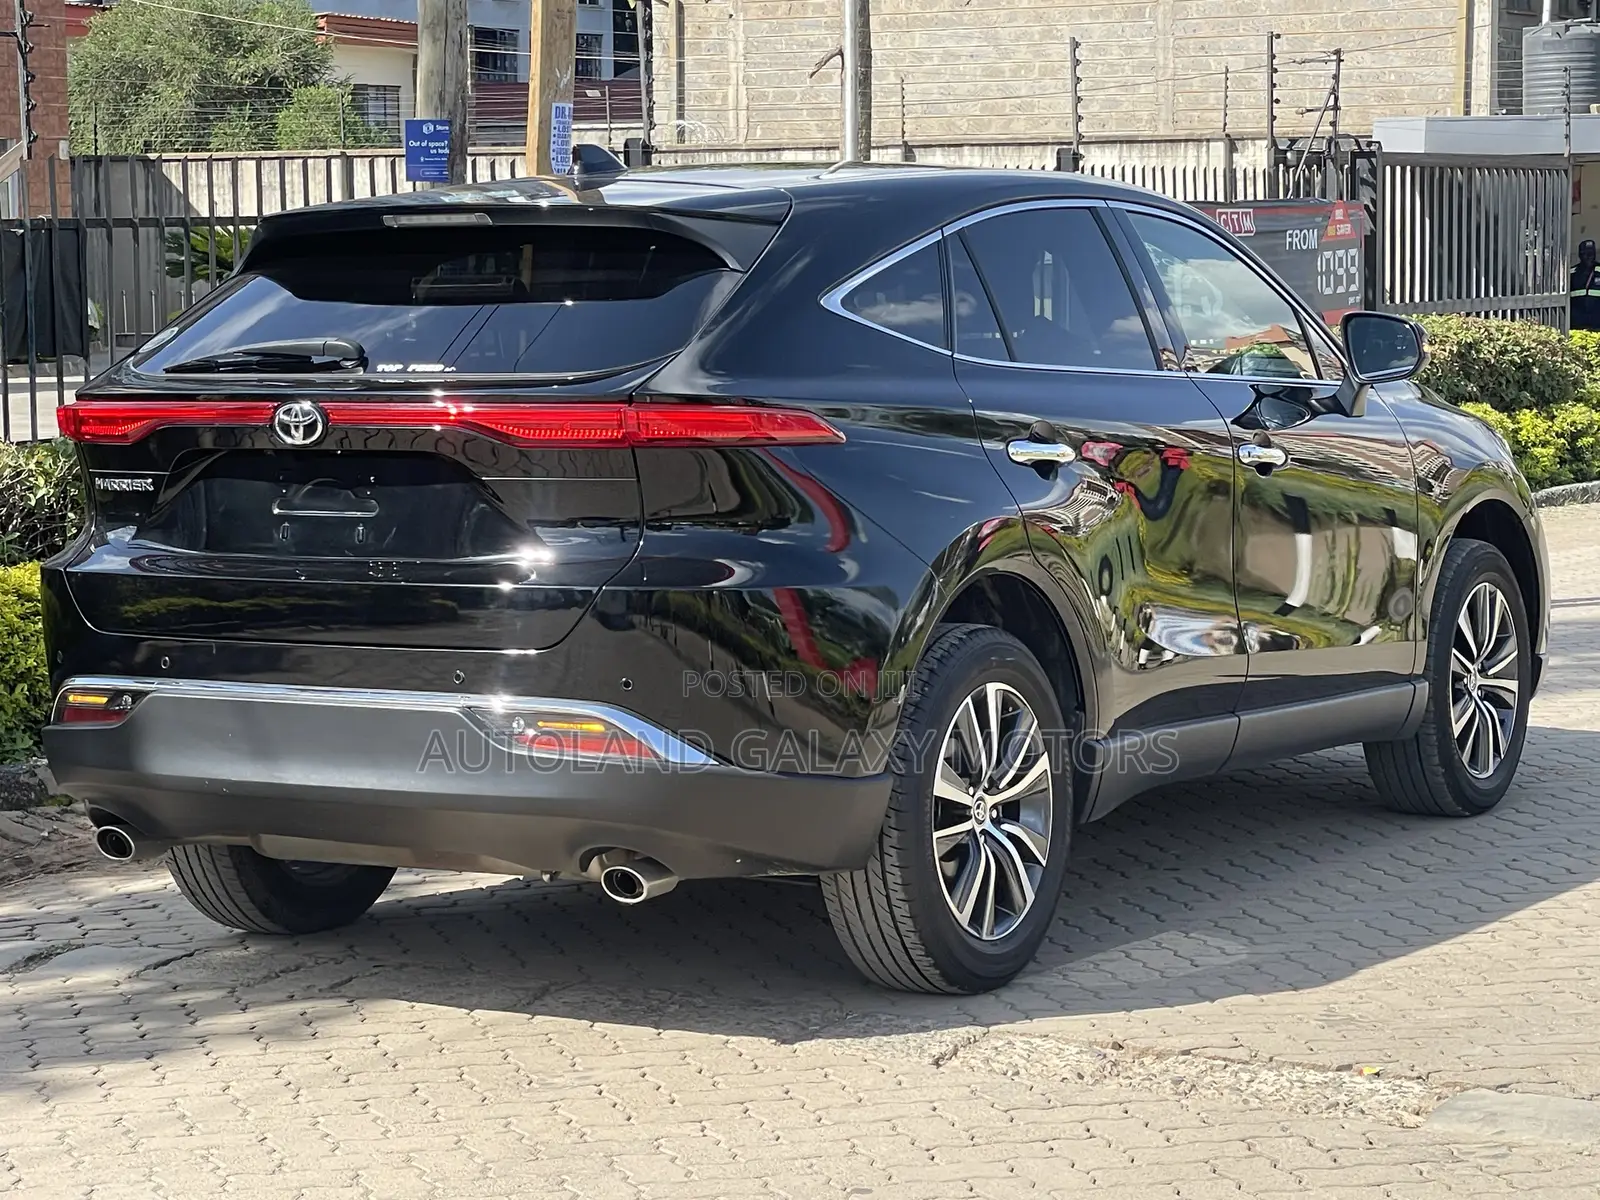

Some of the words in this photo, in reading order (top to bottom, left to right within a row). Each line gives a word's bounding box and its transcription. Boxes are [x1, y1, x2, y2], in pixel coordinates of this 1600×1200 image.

[429, 140, 449, 149] space?
[1220, 213, 1253, 232] CTM
[1285, 228, 1318, 251] FROM
